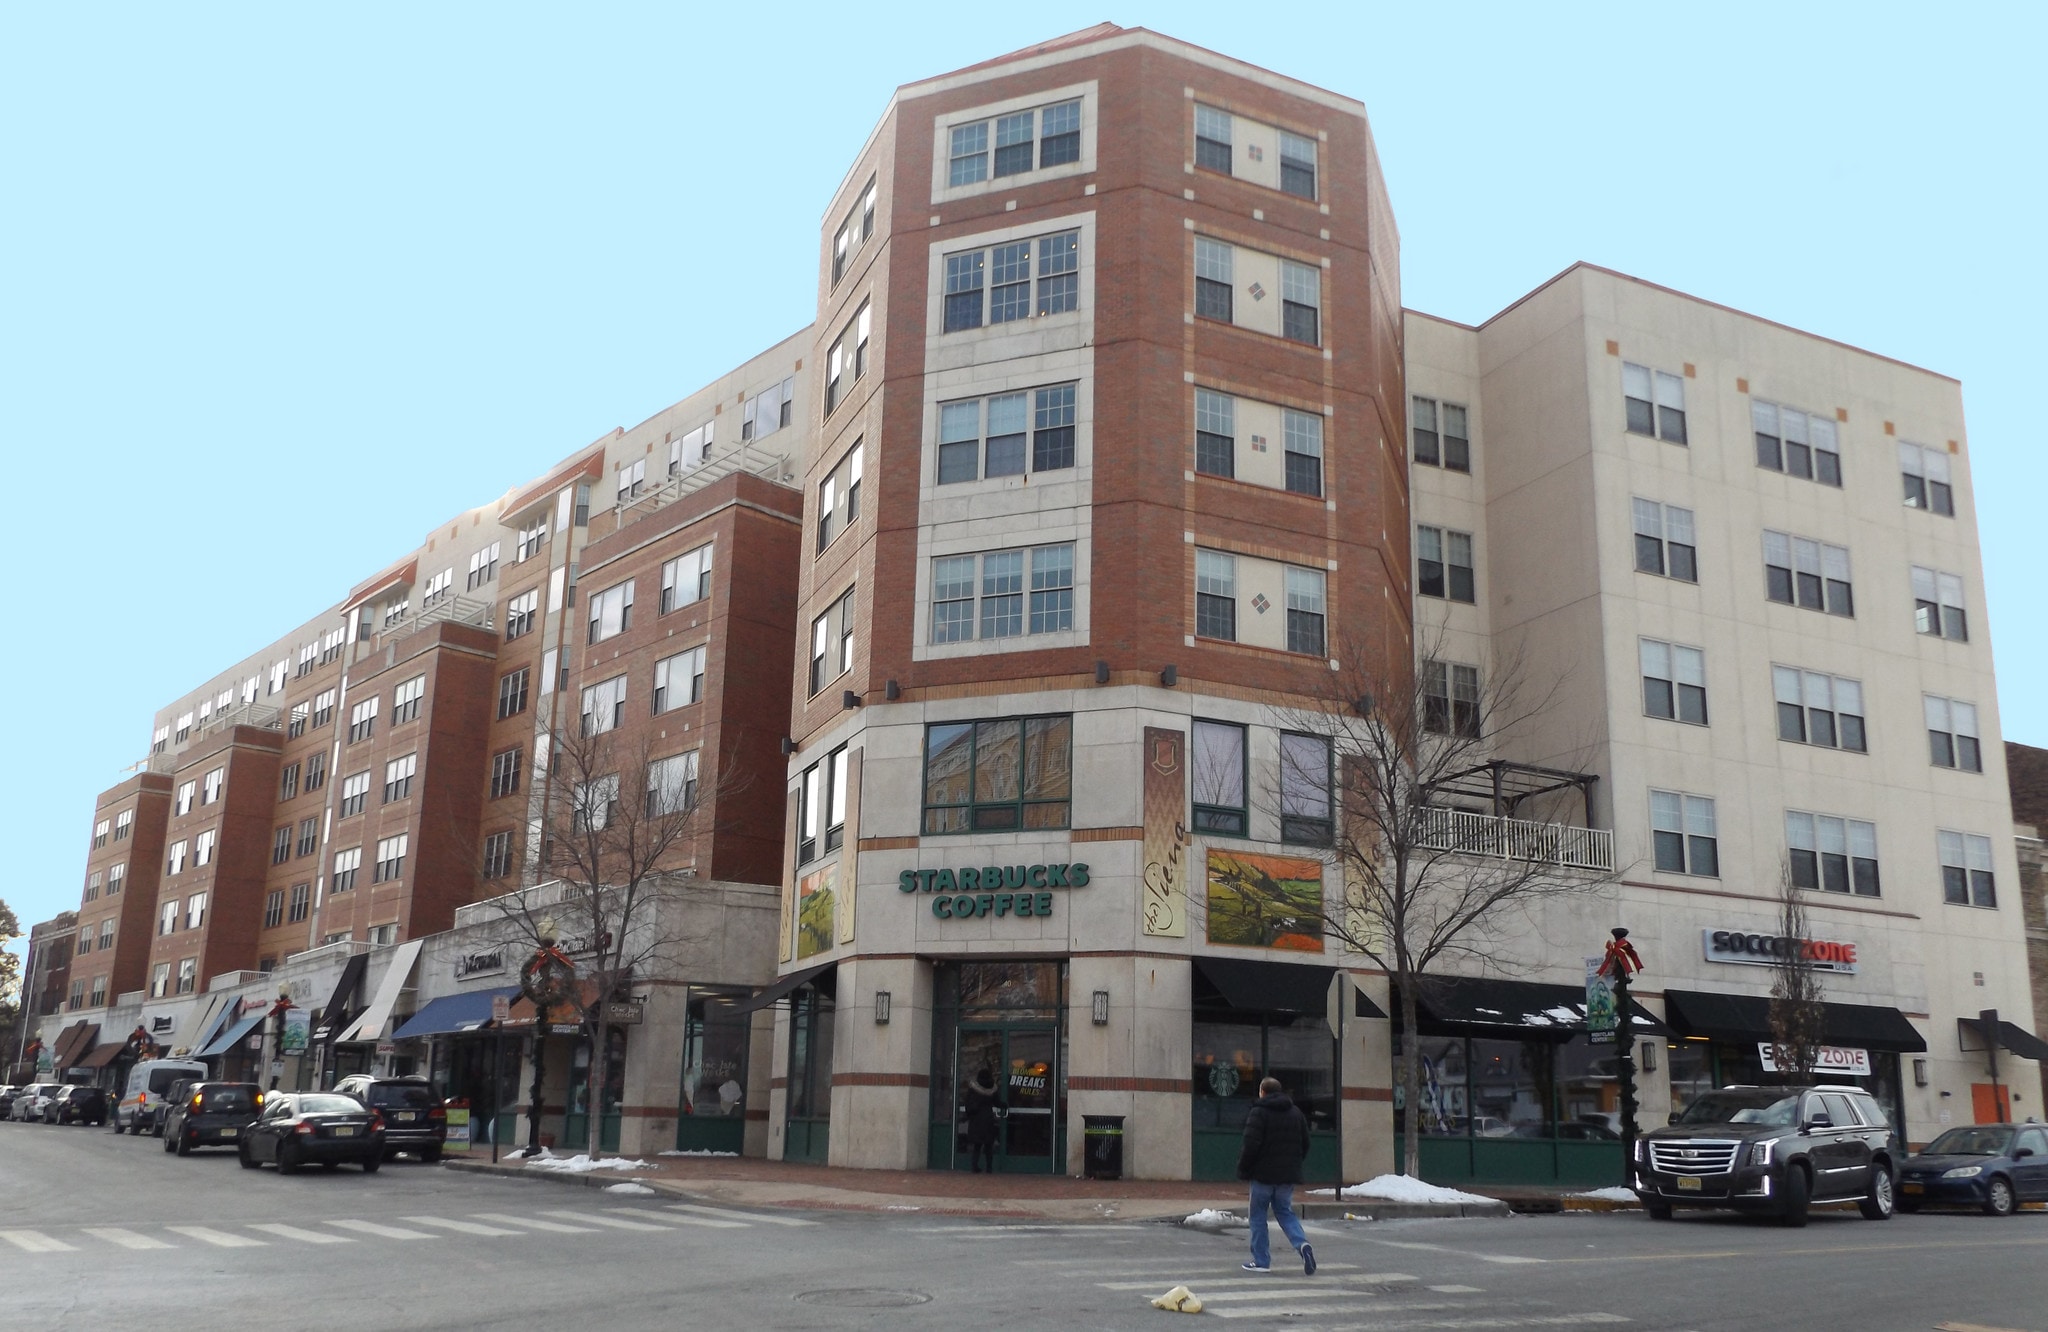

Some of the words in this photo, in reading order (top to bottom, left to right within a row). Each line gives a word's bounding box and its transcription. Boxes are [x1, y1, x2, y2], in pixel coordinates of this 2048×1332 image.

[898, 863, 1091, 893] STARBUCKS
[932, 892, 1053, 919] COFFEE
[1145, 902, 1162, 934] the
[1834, 964, 1853, 972] USA
[1009, 1075, 1046, 1089] BREAKS
[1019, 1087, 1041, 1096] RULES
